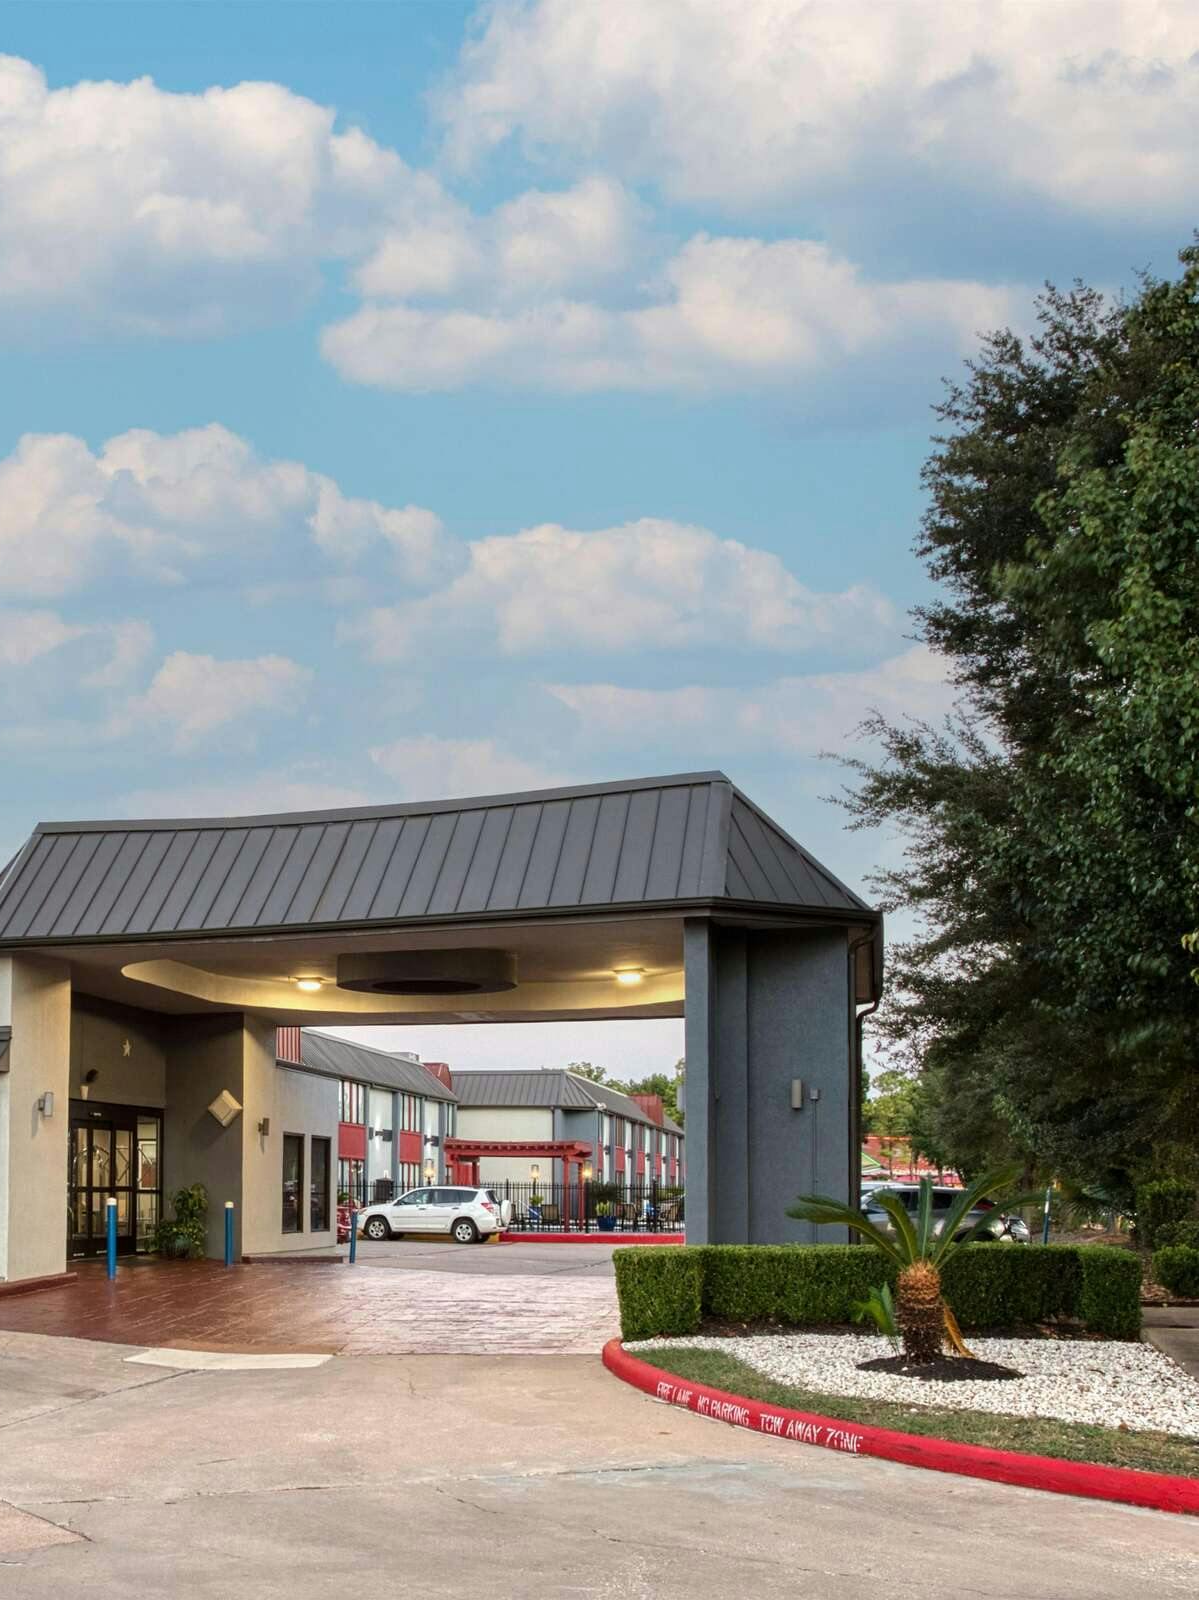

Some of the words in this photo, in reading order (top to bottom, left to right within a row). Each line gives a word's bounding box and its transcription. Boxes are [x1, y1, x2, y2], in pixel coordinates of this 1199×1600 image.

[657, 1381, 673, 1400] FIRE
[671, 1386, 693, 1405] LANE
[697, 1395, 710, 1414] NO
[710, 1399, 750, 1426] PARKING
[760, 1413, 784, 1434] TOW
[786, 1420, 823, 1443] AWAY
[826, 1427, 864, 1452] ZONE
